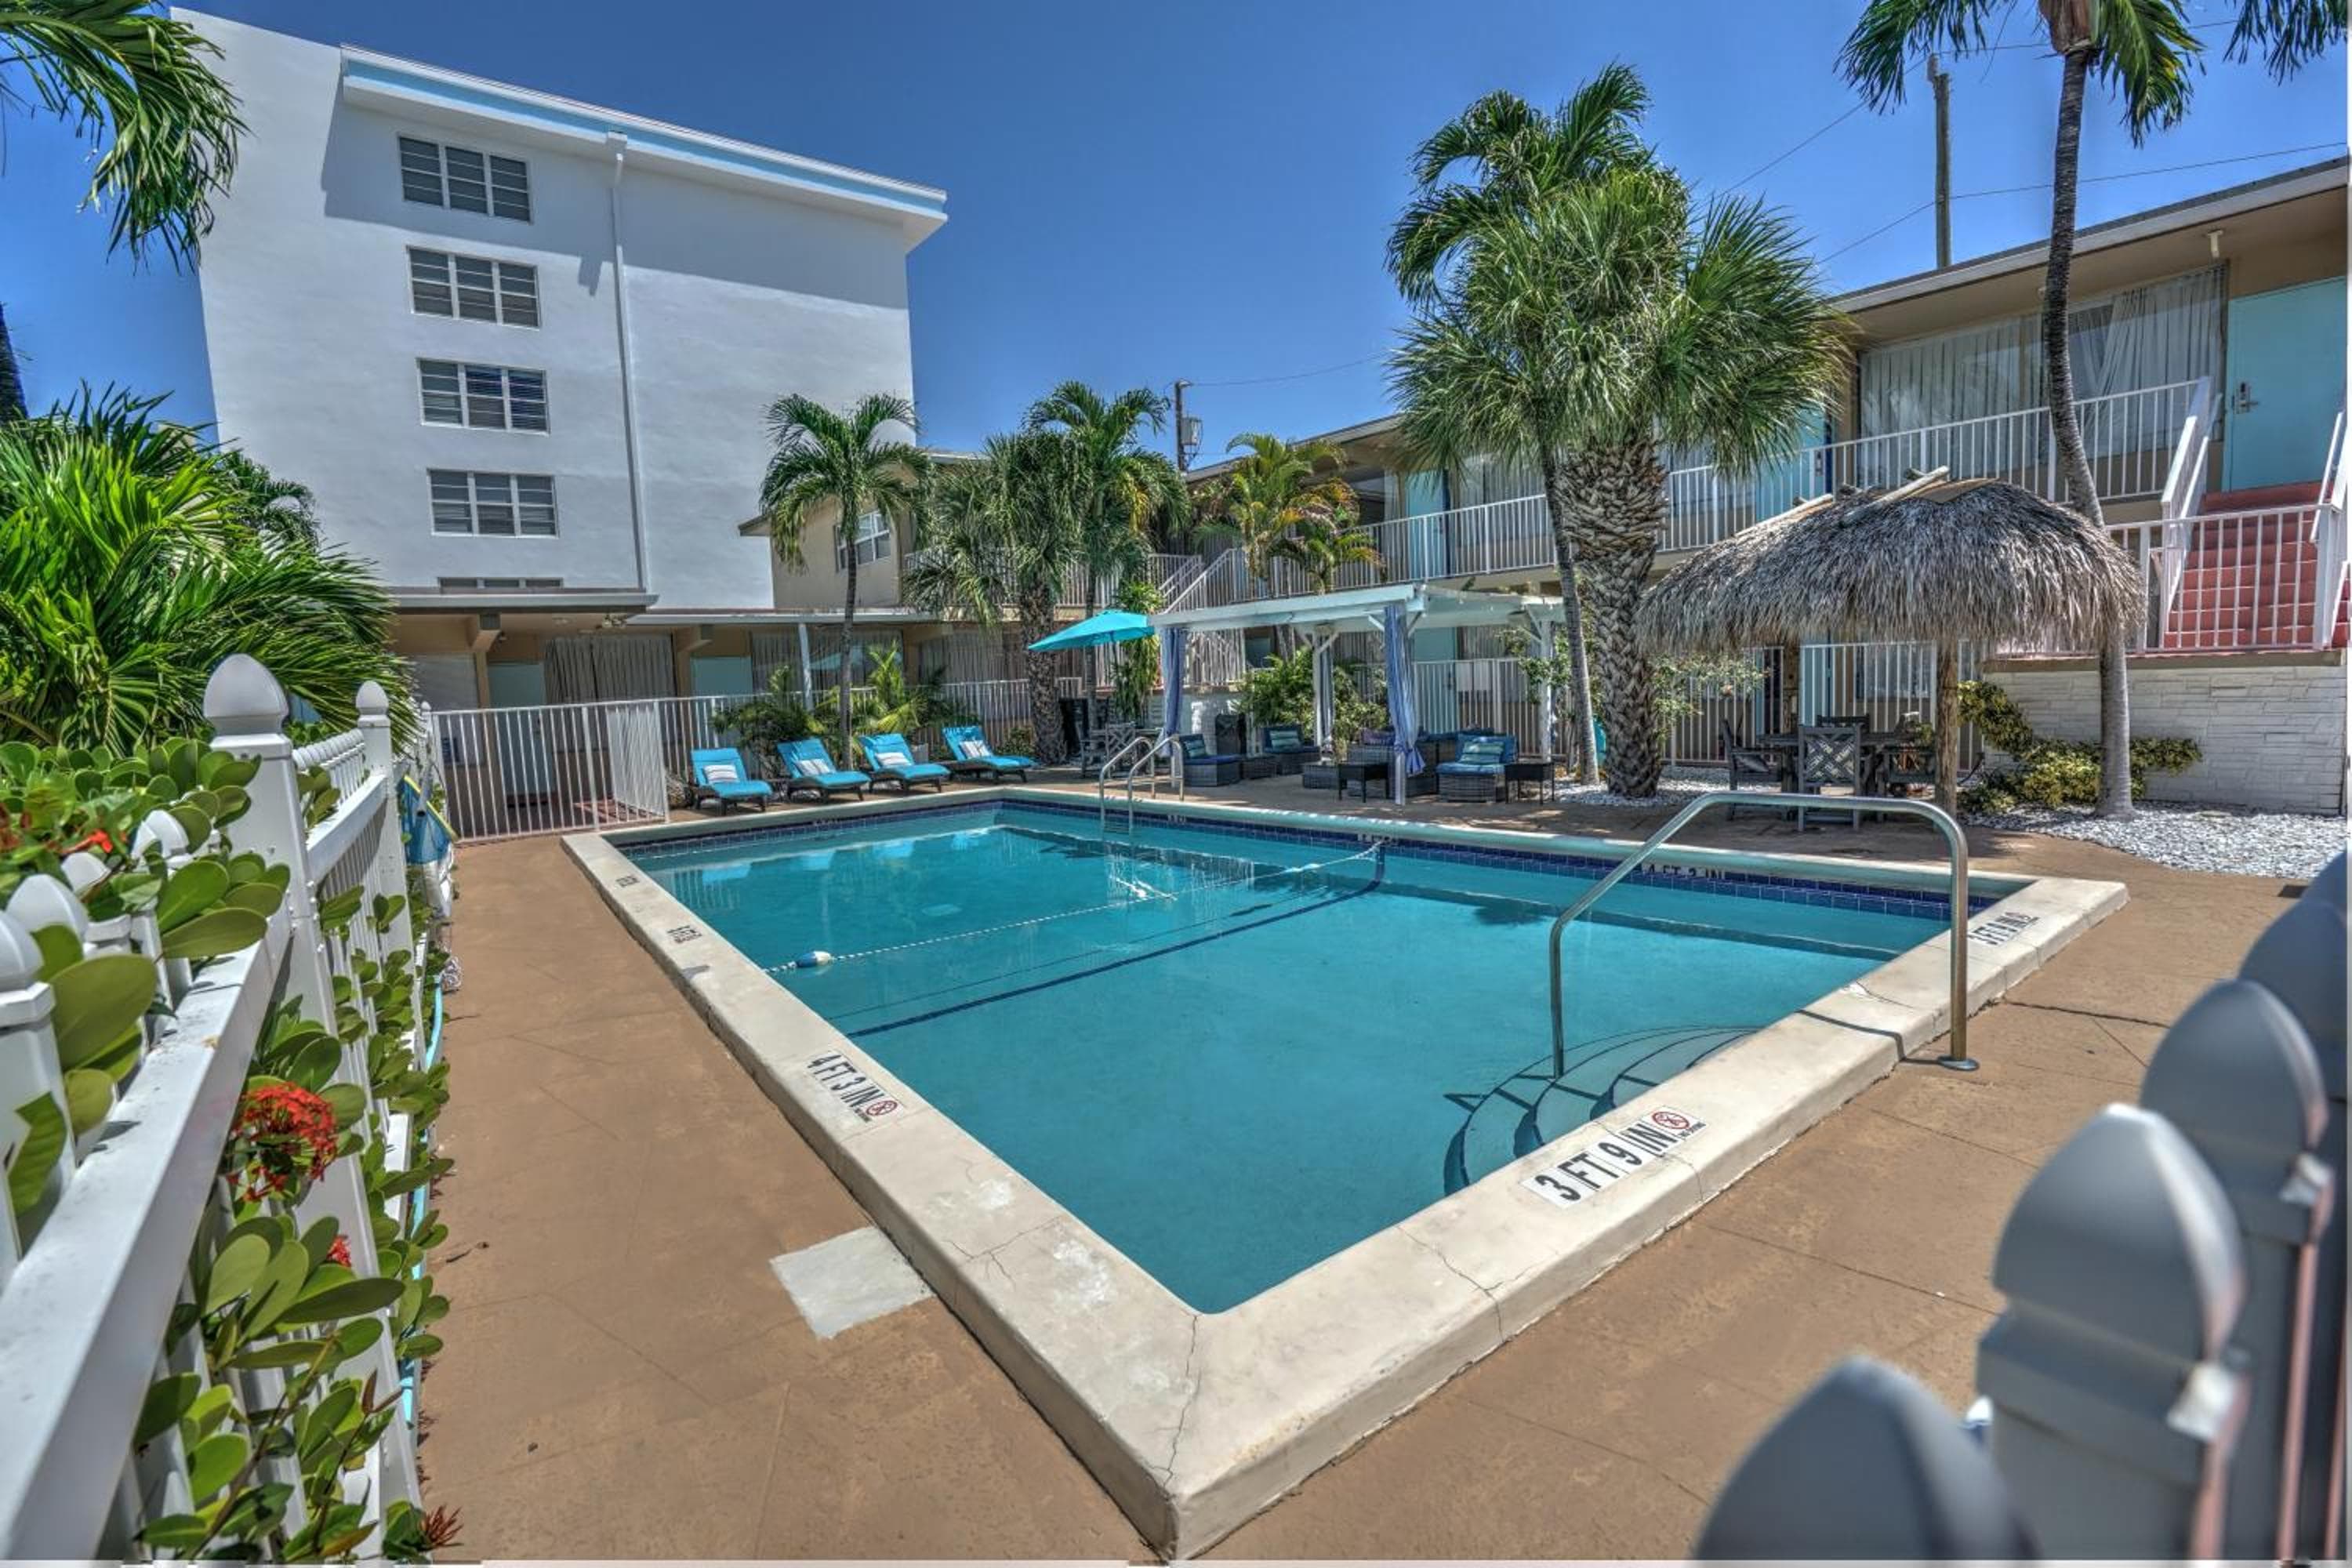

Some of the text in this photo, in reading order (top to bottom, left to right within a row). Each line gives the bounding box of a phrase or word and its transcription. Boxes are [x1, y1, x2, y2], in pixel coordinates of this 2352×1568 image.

[807, 1054, 884, 1108] 4 FT 3 IN
[1619, 1122, 1679, 1152] IN
[1597, 1142, 1643, 1167] 9
[1556, 1152, 1621, 1189] FT
[1534, 1174, 1581, 1201] 3
